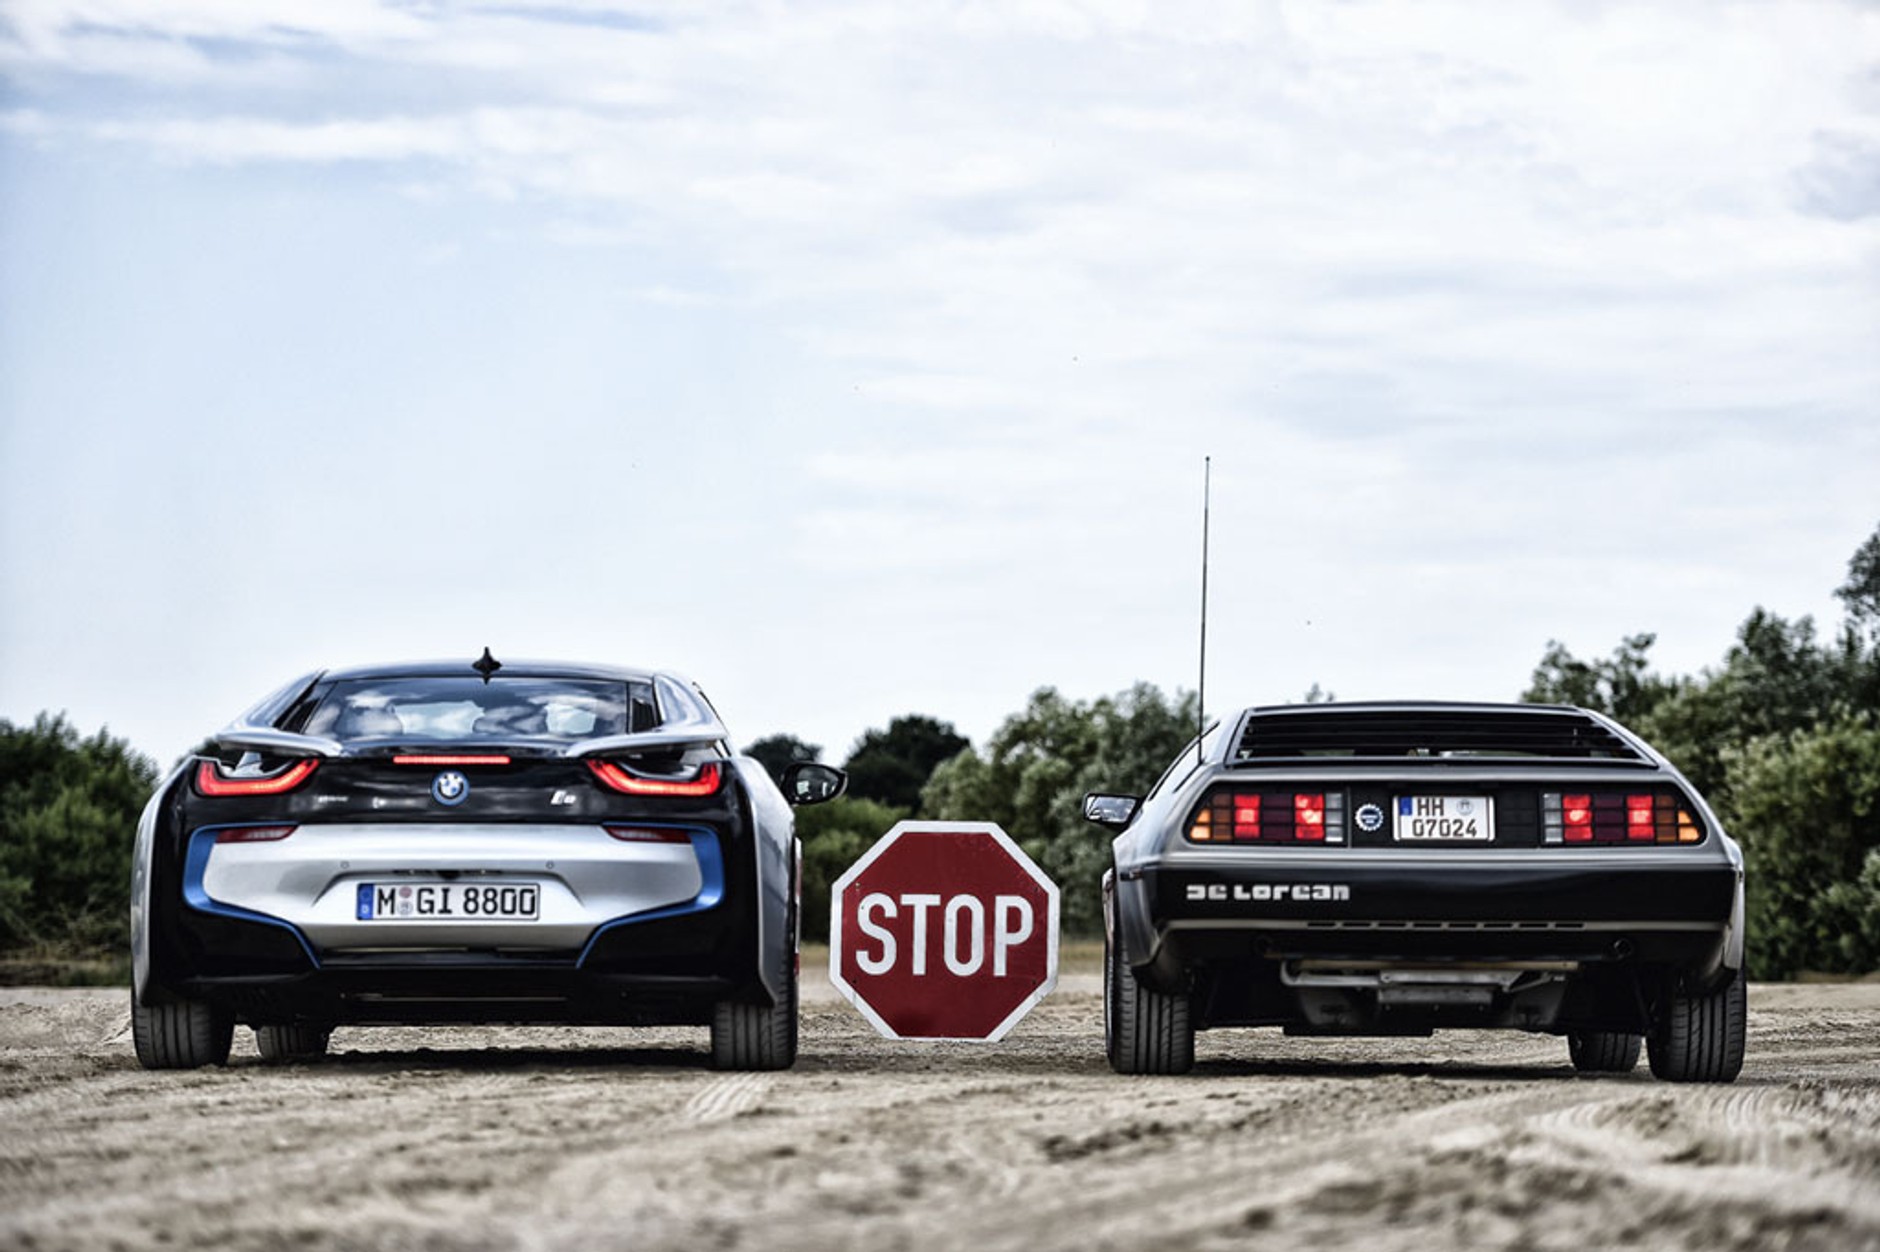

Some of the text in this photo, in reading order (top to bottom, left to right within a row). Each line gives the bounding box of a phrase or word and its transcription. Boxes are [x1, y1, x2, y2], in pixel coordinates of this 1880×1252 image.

[1417, 798, 1444, 816] HH
[1412, 819, 1477, 837] 07024
[377, 887, 535, 915] M GI 8800
[855, 892, 1034, 977] STOP
